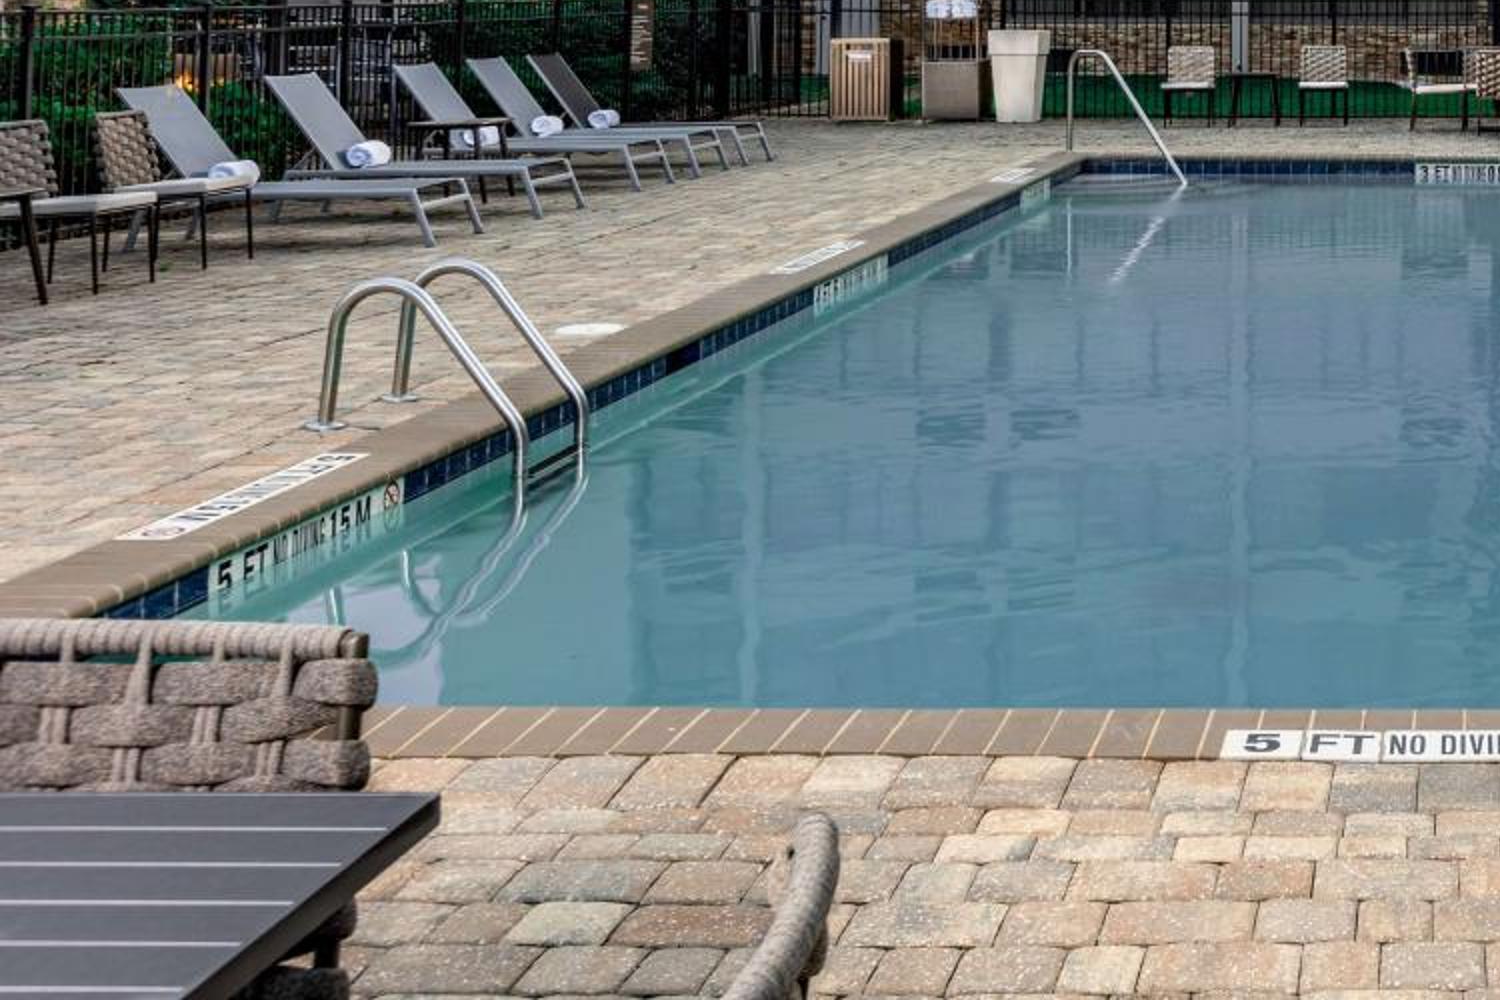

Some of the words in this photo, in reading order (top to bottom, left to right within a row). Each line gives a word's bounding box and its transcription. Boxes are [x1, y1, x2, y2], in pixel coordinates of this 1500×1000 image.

[217, 559, 233, 590] 5
[244, 543, 269, 581] FT
[356, 494, 371, 527] M
[1243, 733, 1281, 753] 5
[1309, 733, 1375, 755] FT
[1389, 734, 1427, 755] NO
